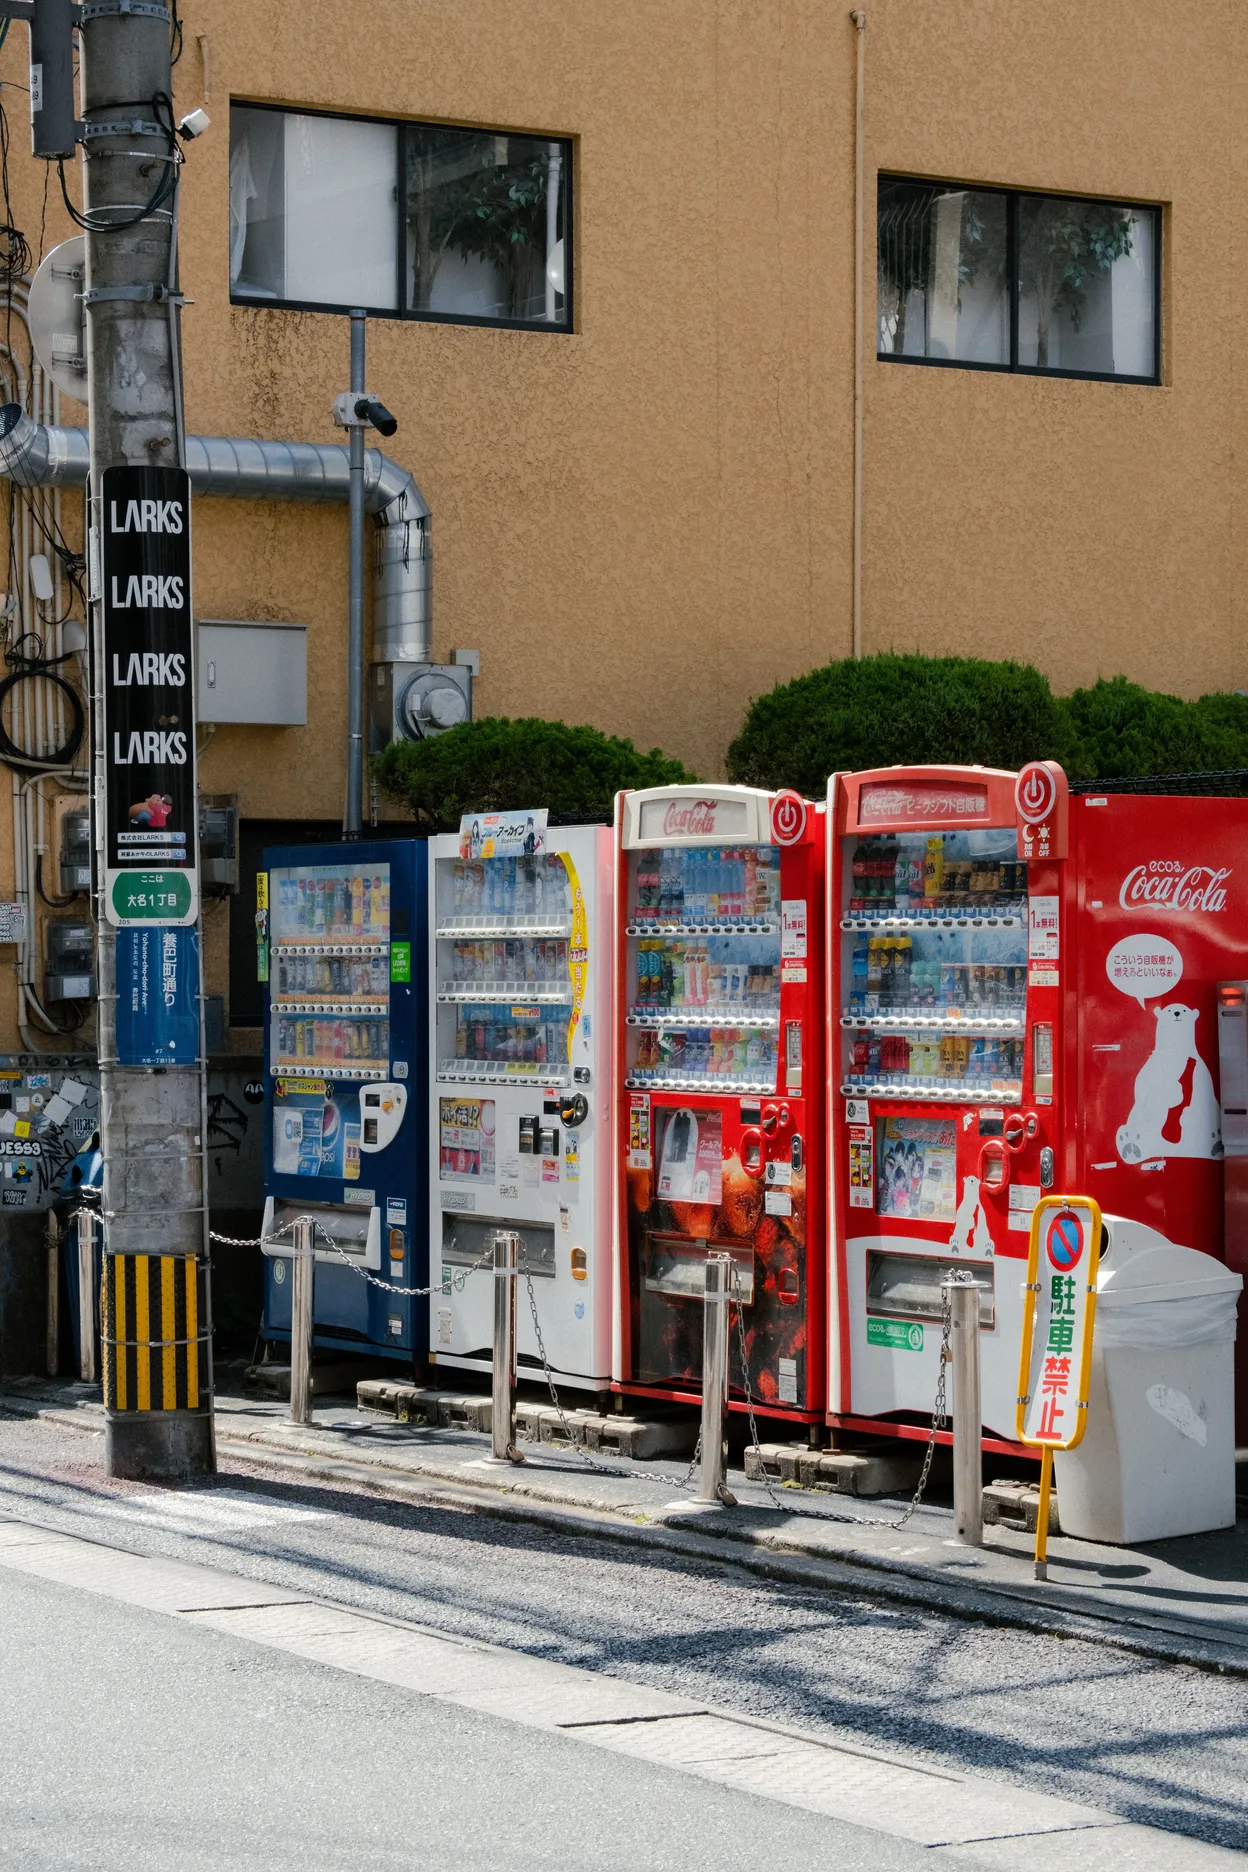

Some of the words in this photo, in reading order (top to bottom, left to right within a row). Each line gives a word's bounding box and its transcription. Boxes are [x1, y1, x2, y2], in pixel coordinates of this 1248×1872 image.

[111, 500, 183, 534] LARKS
[111, 575, 184, 609] LARKS
[113, 653, 186, 687] LARKS
[114, 732, 187, 765] LARKS
[663, 800, 718, 836] Coca-Cola
[141, 874, 164, 883] ここは
[1119, 865, 1233, 912] Coca-Cola
[127, 893, 177, 907] 大名1丁目
[162, 932, 177, 1007] 養巴町通り
[1113, 955, 1174, 966] こういう自販機が
[320, 1150, 335, 1164] epsi
[1035, 1275, 1076, 1439] 駐車禁止
